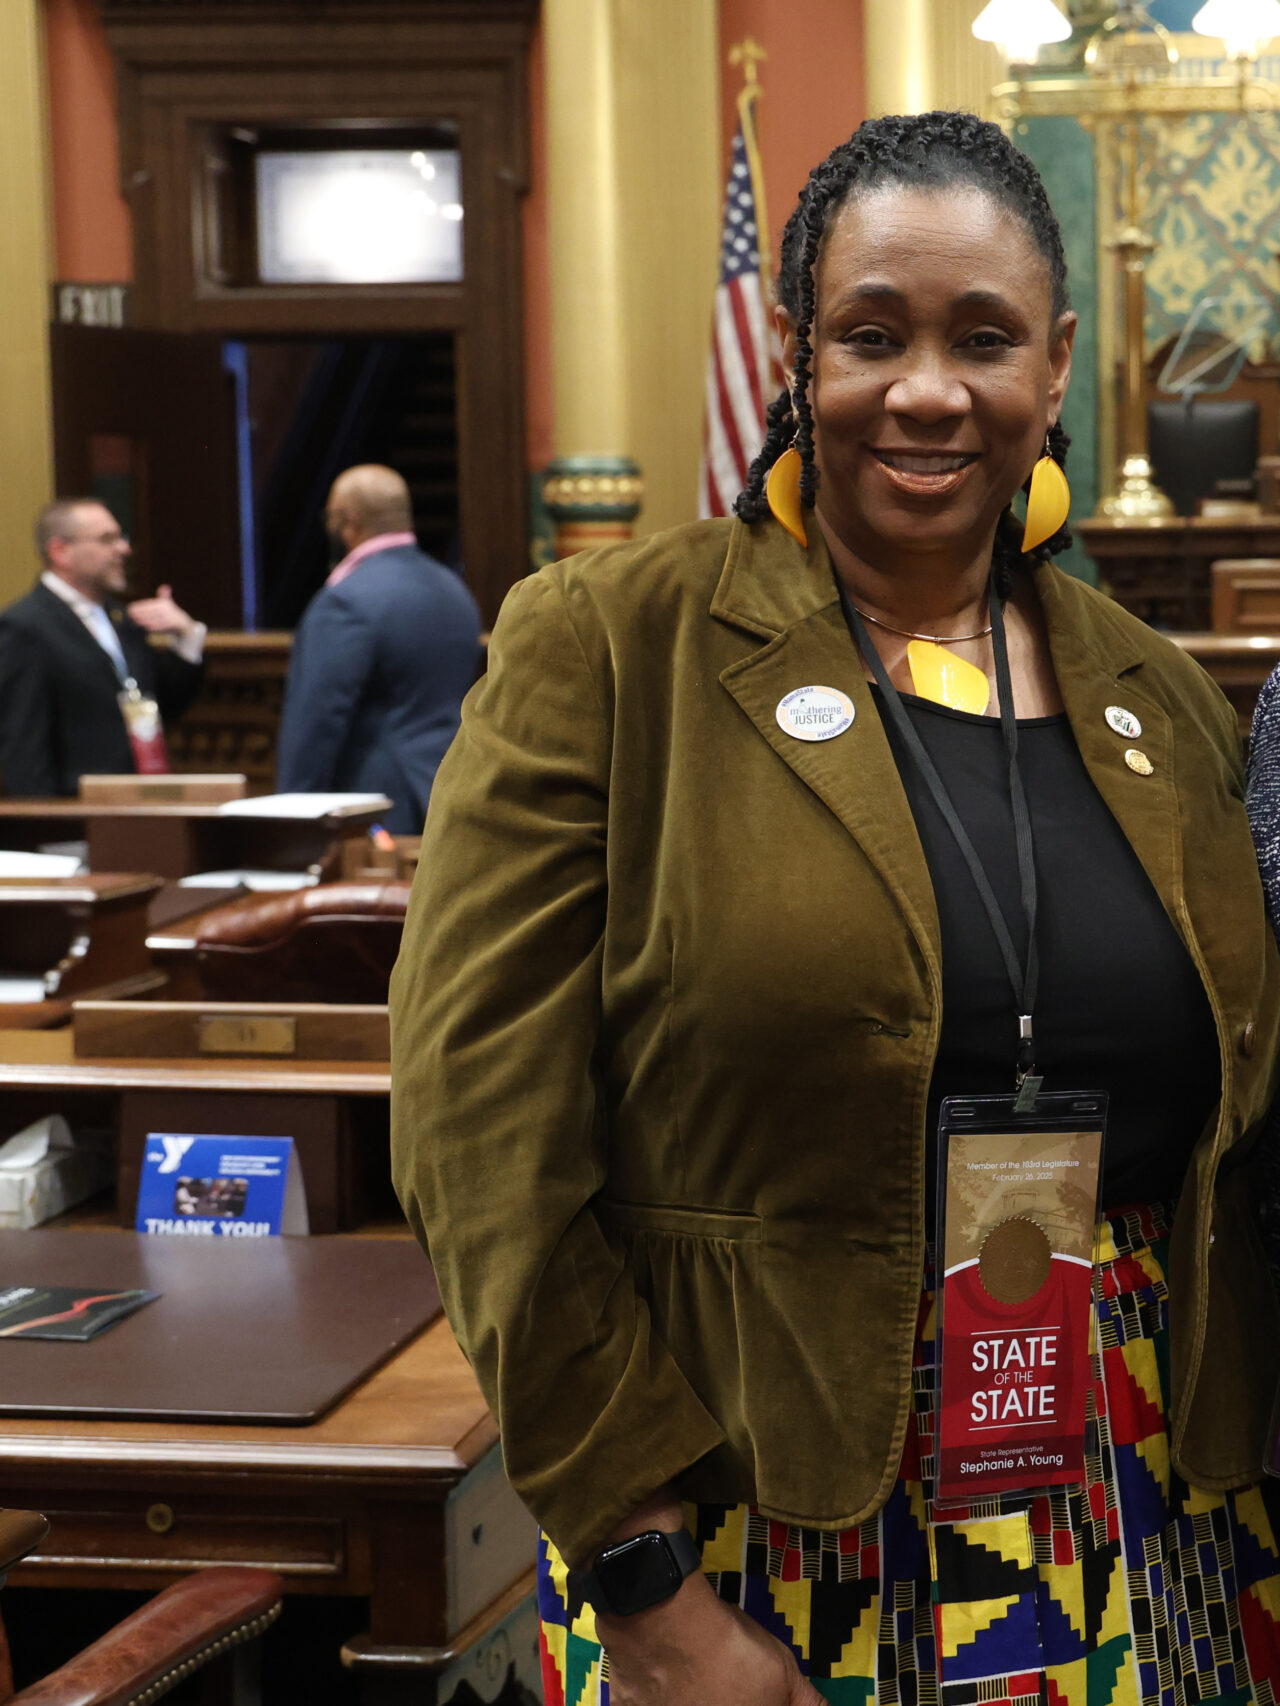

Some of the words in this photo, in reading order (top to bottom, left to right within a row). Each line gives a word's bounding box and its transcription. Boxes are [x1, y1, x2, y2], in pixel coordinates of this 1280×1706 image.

[60, 287, 124, 329] EXIT
[795, 714, 834, 725] JUSTICE
[967, 1162, 998, 1171] Member
[1000, 1161, 1008, 1169] of
[1008, 1161, 1020, 1169] the
[1022, 1160, 1041, 1169] 103rd
[1042, 1159, 1080, 1170] Legislature
[992, 1173, 1024, 1183] February
[1036, 1172, 1054, 1180] 2025
[145, 1218, 216, 1236] THANK
[219, 1220, 271, 1237] YOU!
[972, 1336, 1057, 1372] STATE
[994, 1372, 1011, 1385] OF
[1013, 1370, 1034, 1383] THE
[971, 1385, 1055, 1422] STATE
[980, 1450, 997, 1458] State
[998, 1446, 1044, 1457] Representative
[960, 1458, 1014, 1474] Stephanie
[1017, 1457, 1028, 1468] A.
[1030, 1454, 1064, 1467] Young
